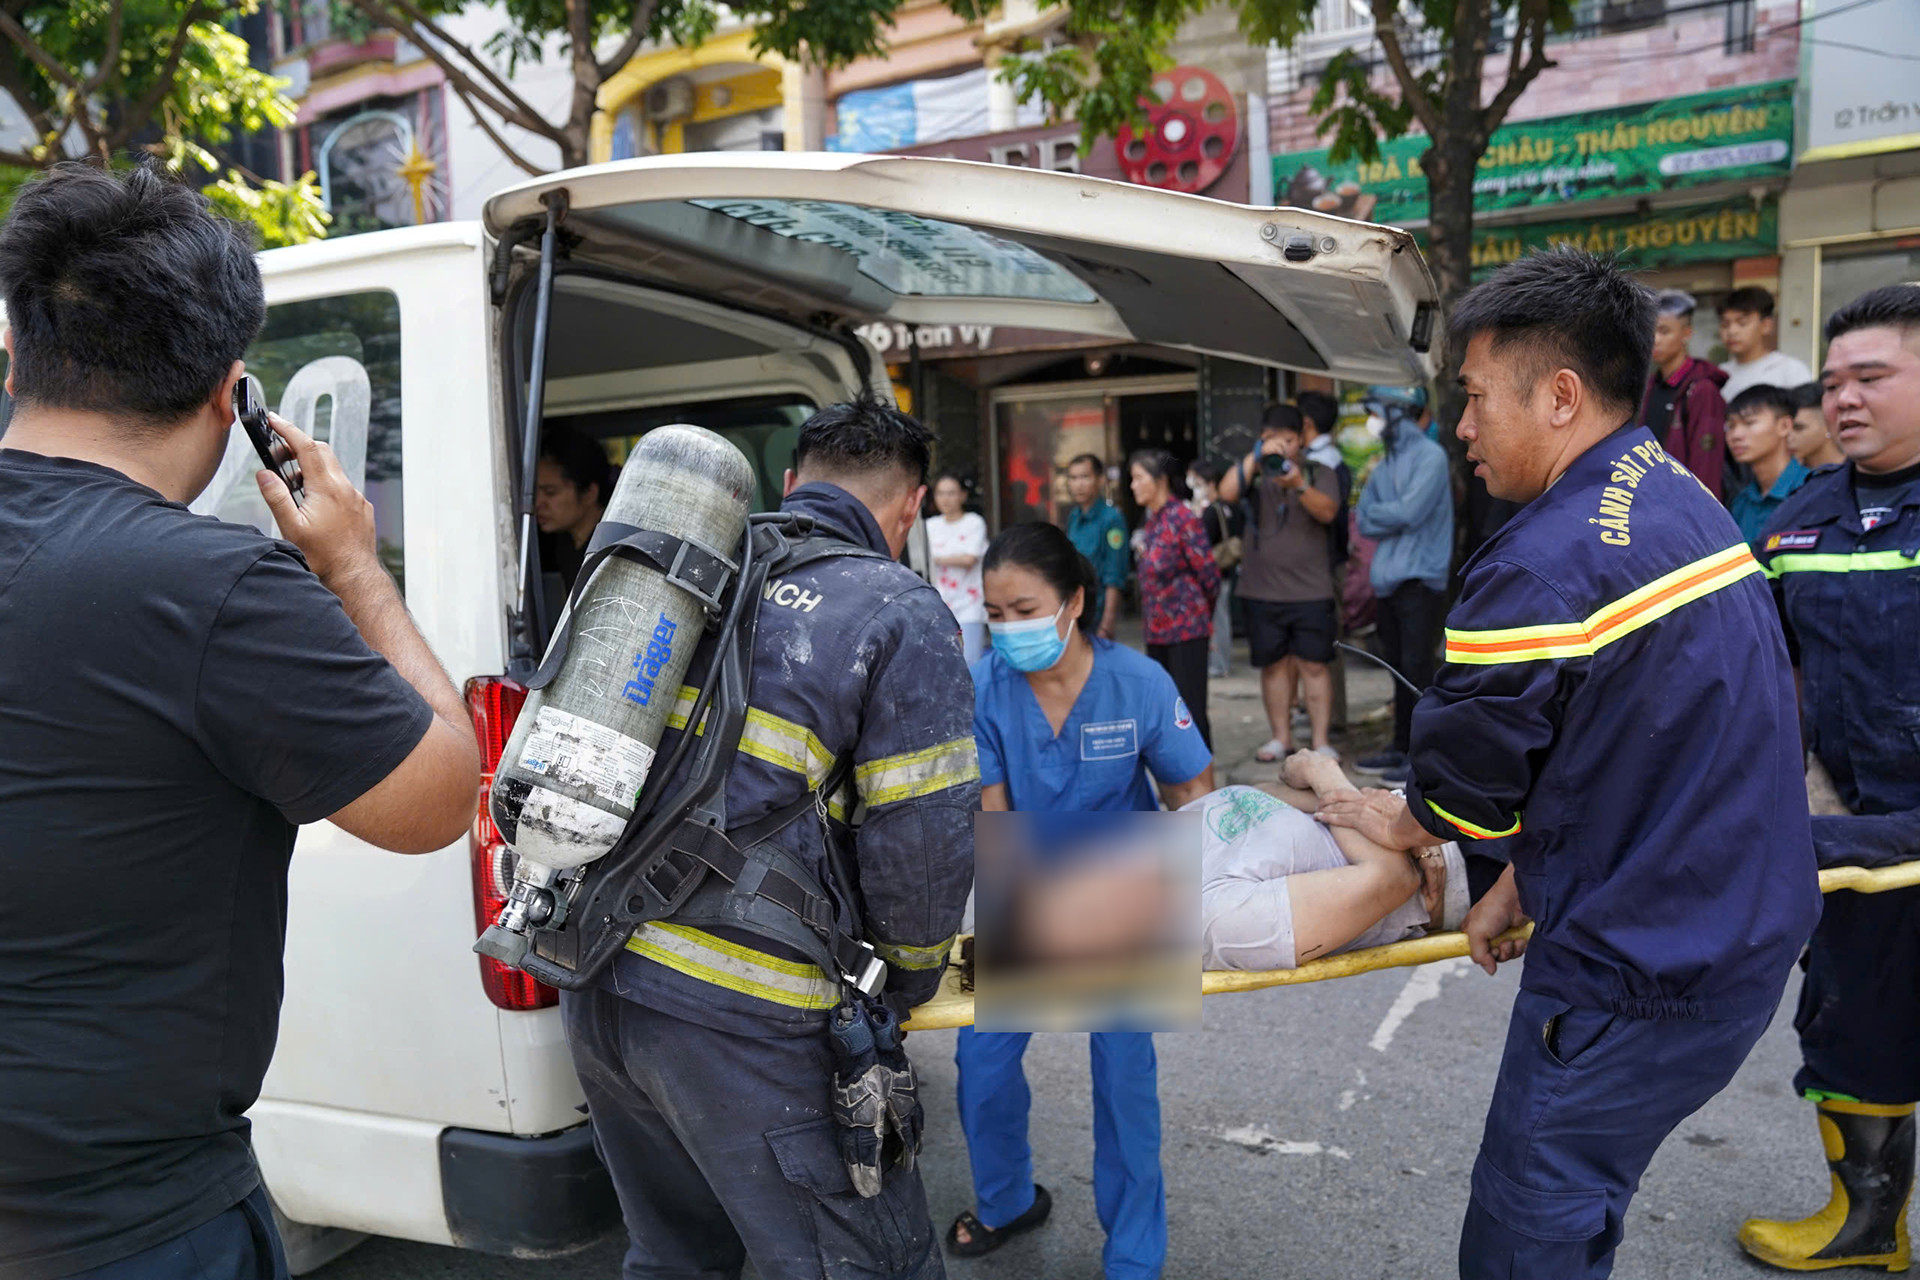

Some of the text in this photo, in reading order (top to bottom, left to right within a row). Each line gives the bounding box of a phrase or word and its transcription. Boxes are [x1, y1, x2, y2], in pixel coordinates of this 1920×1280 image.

[1646, 105, 1768, 144] NGUYÊN
[1625, 208, 1759, 249] NGUYÊN
[1610, 453, 1648, 489] SÁT
[1588, 486, 1634, 547] CẢNH
[622, 612, 677, 706] Dräger
